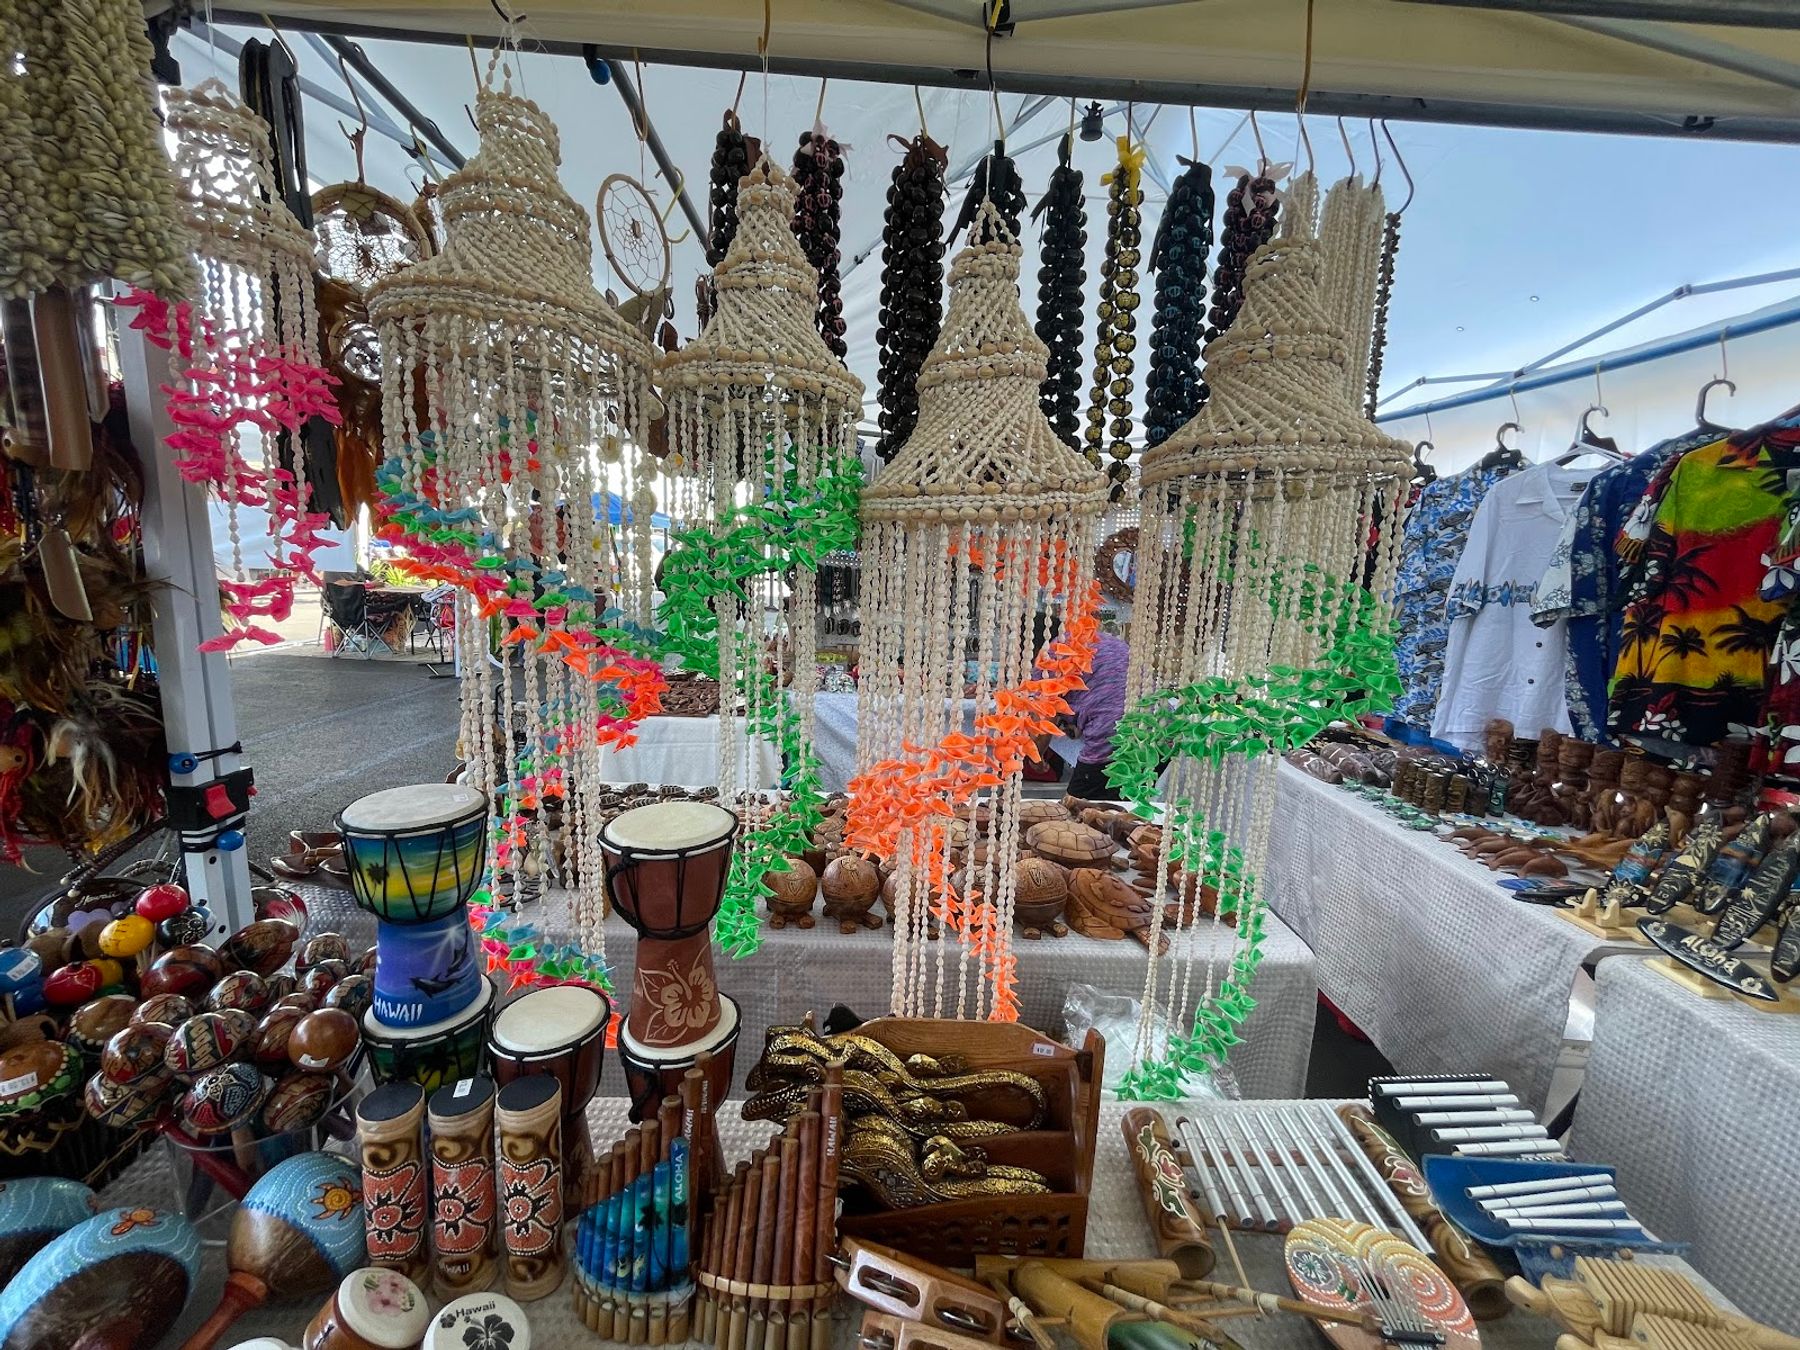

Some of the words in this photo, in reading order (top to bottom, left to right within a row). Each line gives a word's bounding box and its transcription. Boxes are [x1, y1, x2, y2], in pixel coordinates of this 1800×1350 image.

[373, 994, 423, 1022] HAWAII
[684, 1108, 694, 1141] AWAII
[826, 1116, 837, 1157] HAWAII
[674, 1152, 684, 1200] ALOHA
[455, 1300, 496, 1318] Hawaii
